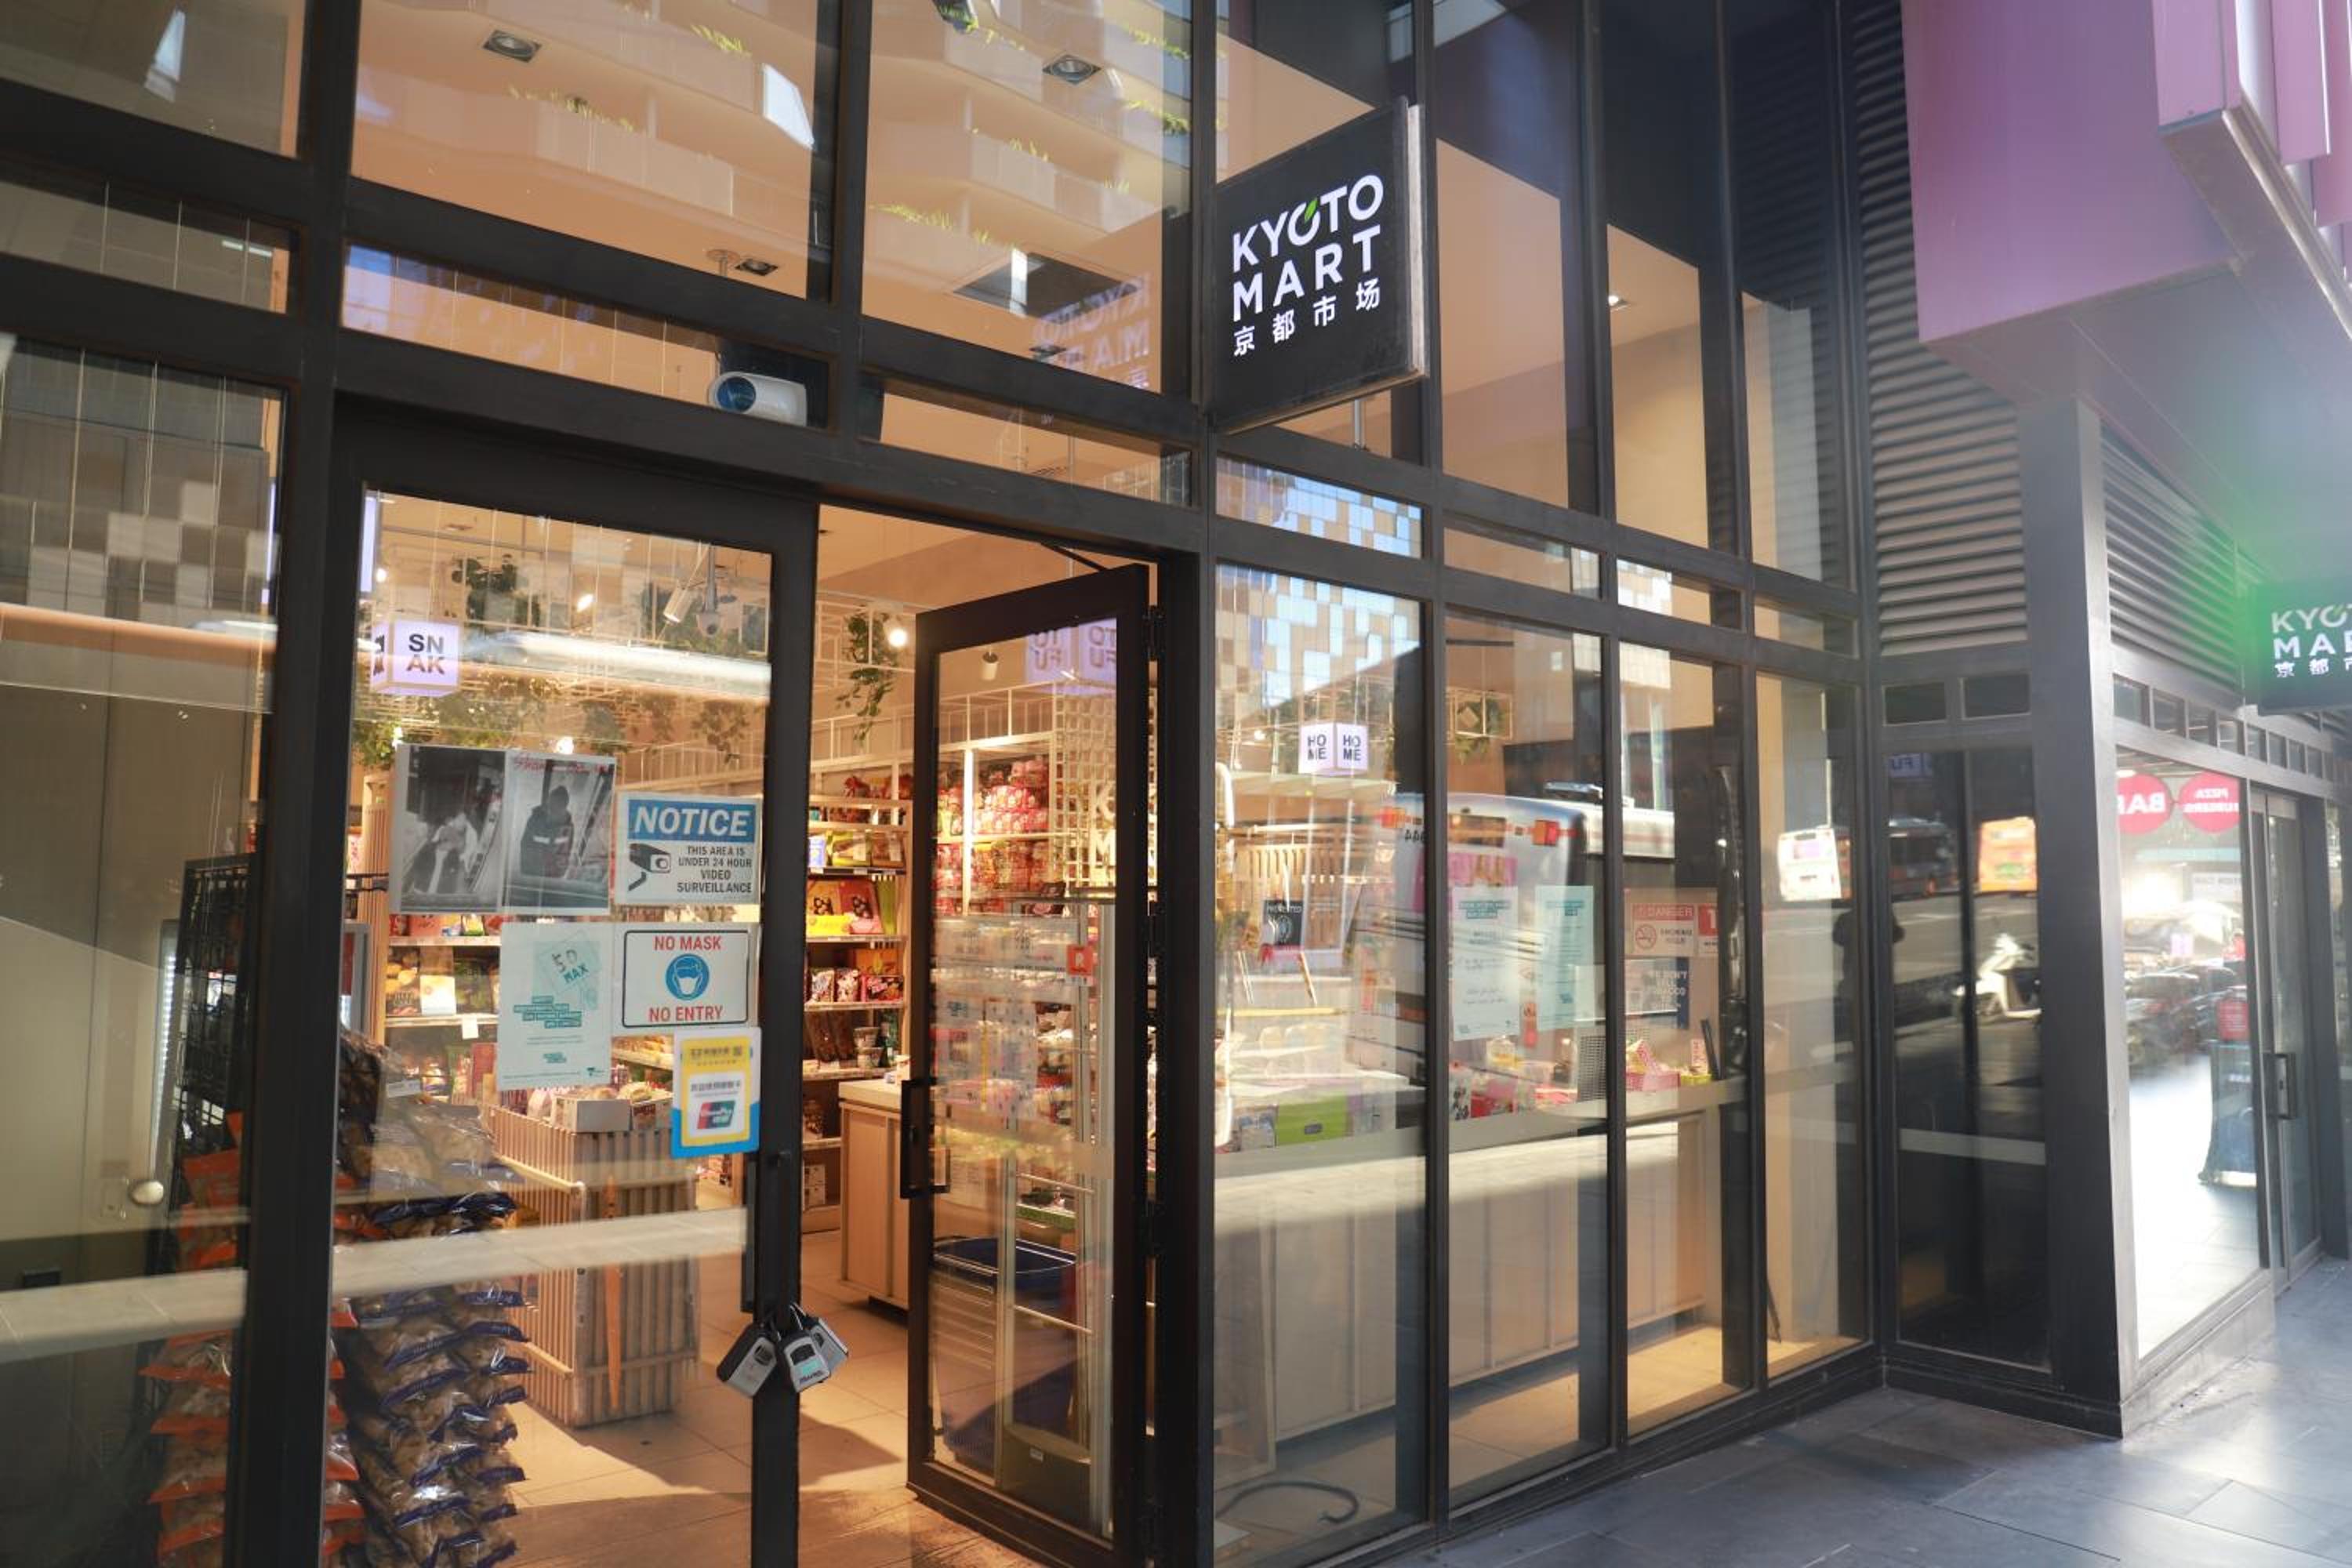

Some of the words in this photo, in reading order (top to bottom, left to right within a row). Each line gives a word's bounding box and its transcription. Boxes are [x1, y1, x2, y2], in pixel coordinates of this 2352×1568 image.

[1233, 175, 1384, 272] KYOTO
[1233, 224, 1381, 321] MART
[1234, 278, 1380, 356] 京都市场
[2271, 603, 2352, 633] KYO
[408, 633, 445, 653] SN
[406, 654, 445, 675] AK
[1307, 733, 1327, 747] HO
[1343, 734, 1362, 748] HO
[1307, 747, 1327, 761] ME
[1343, 747, 1362, 761] ME
[634, 806, 751, 837] NOTICE
[688, 846, 707, 855] THIS
[710, 846, 733, 855] AREA
[735, 847, 745, 856] IS
[679, 858, 710, 866] UNDER
[727, 858, 753, 867] HOUR
[700, 869, 731, 880] VIDEO
[677, 882, 753, 894] SURVEILLANCE
[654, 936, 676, 951] NO
[679, 935, 722, 951] MASK
[562, 964, 590, 984] MAX
[649, 1007, 671, 1023] NO
[676, 1005, 724, 1022] ENTRY
